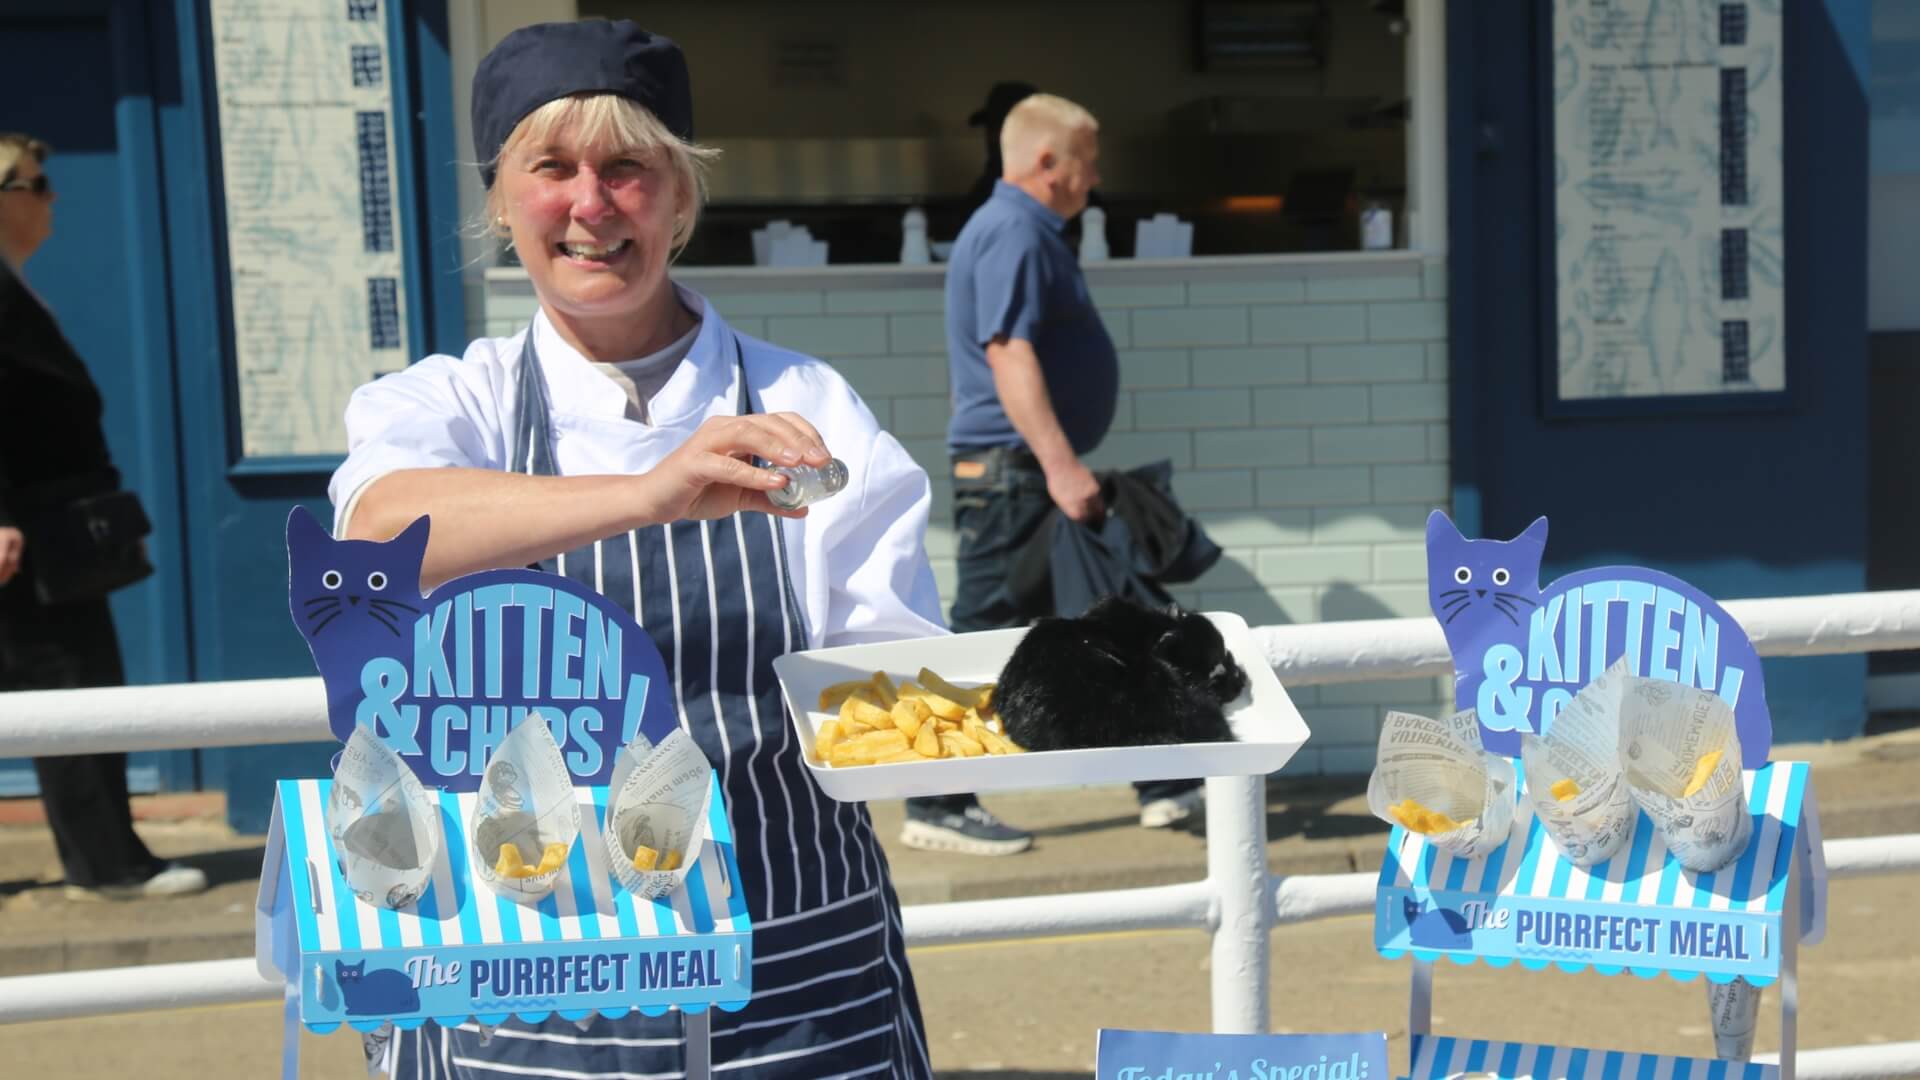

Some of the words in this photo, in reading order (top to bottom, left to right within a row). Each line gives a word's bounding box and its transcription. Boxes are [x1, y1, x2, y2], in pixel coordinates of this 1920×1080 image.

[414, 583, 622, 699] KITTEN
[1527, 580, 1719, 690] KITTEN
[1462, 900, 1509, 931] The
[1516, 910, 1662, 955] PURRFECT
[1669, 920, 1752, 962] MEAL
[404, 955, 462, 989] The
[470, 953, 630, 1000] PURRFECT
[639, 949, 723, 991] MEAL
